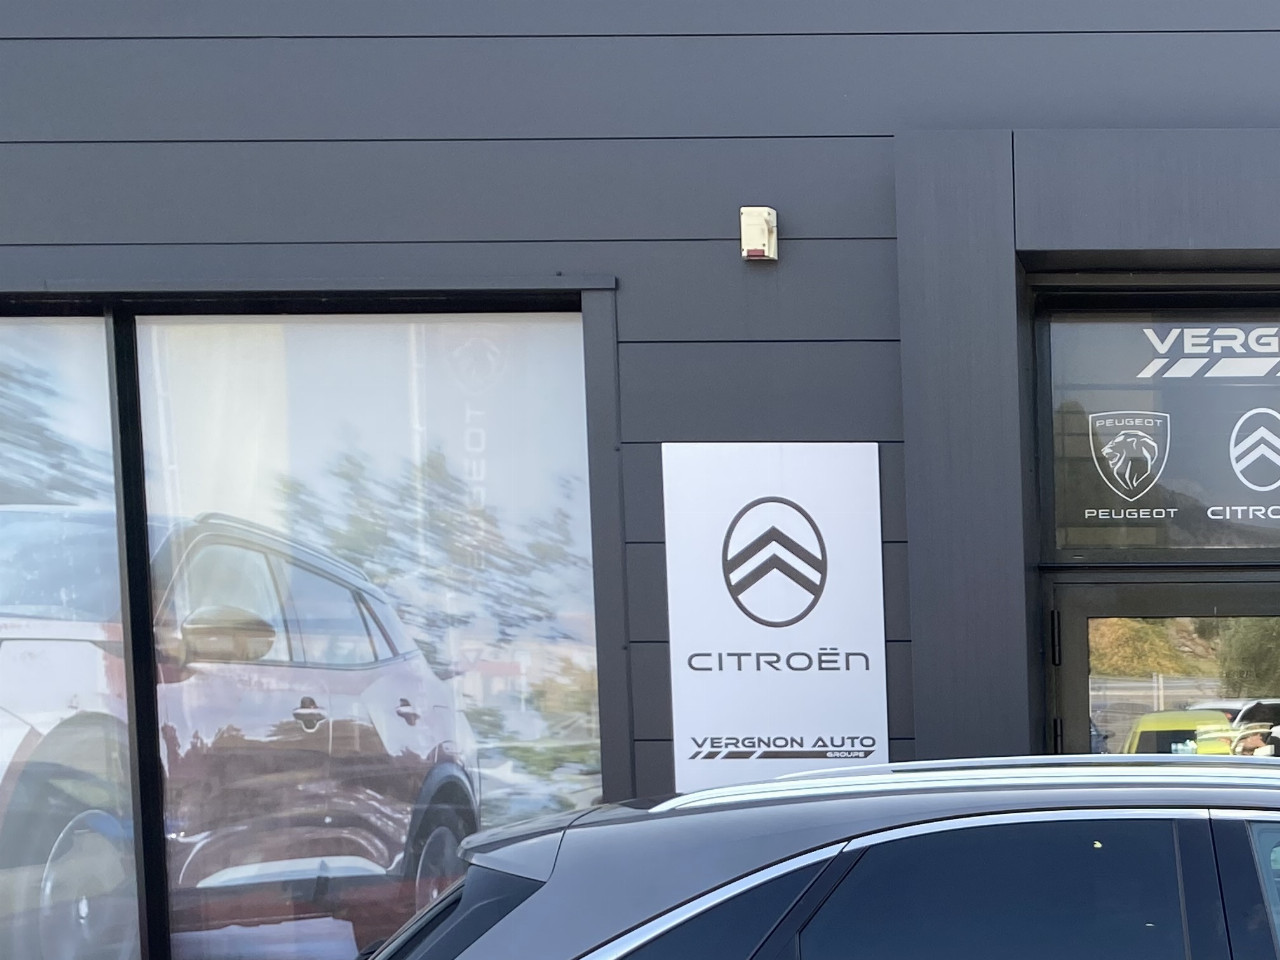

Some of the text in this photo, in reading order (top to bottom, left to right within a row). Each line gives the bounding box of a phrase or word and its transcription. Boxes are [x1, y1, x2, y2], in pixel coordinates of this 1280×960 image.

[1095, 417, 1163, 428] PEUGEOT
[1084, 508, 1179, 519] PEUGEOT
[687, 647, 870, 671] CITROËN
[690, 735, 877, 748] VERGNON AUTO
